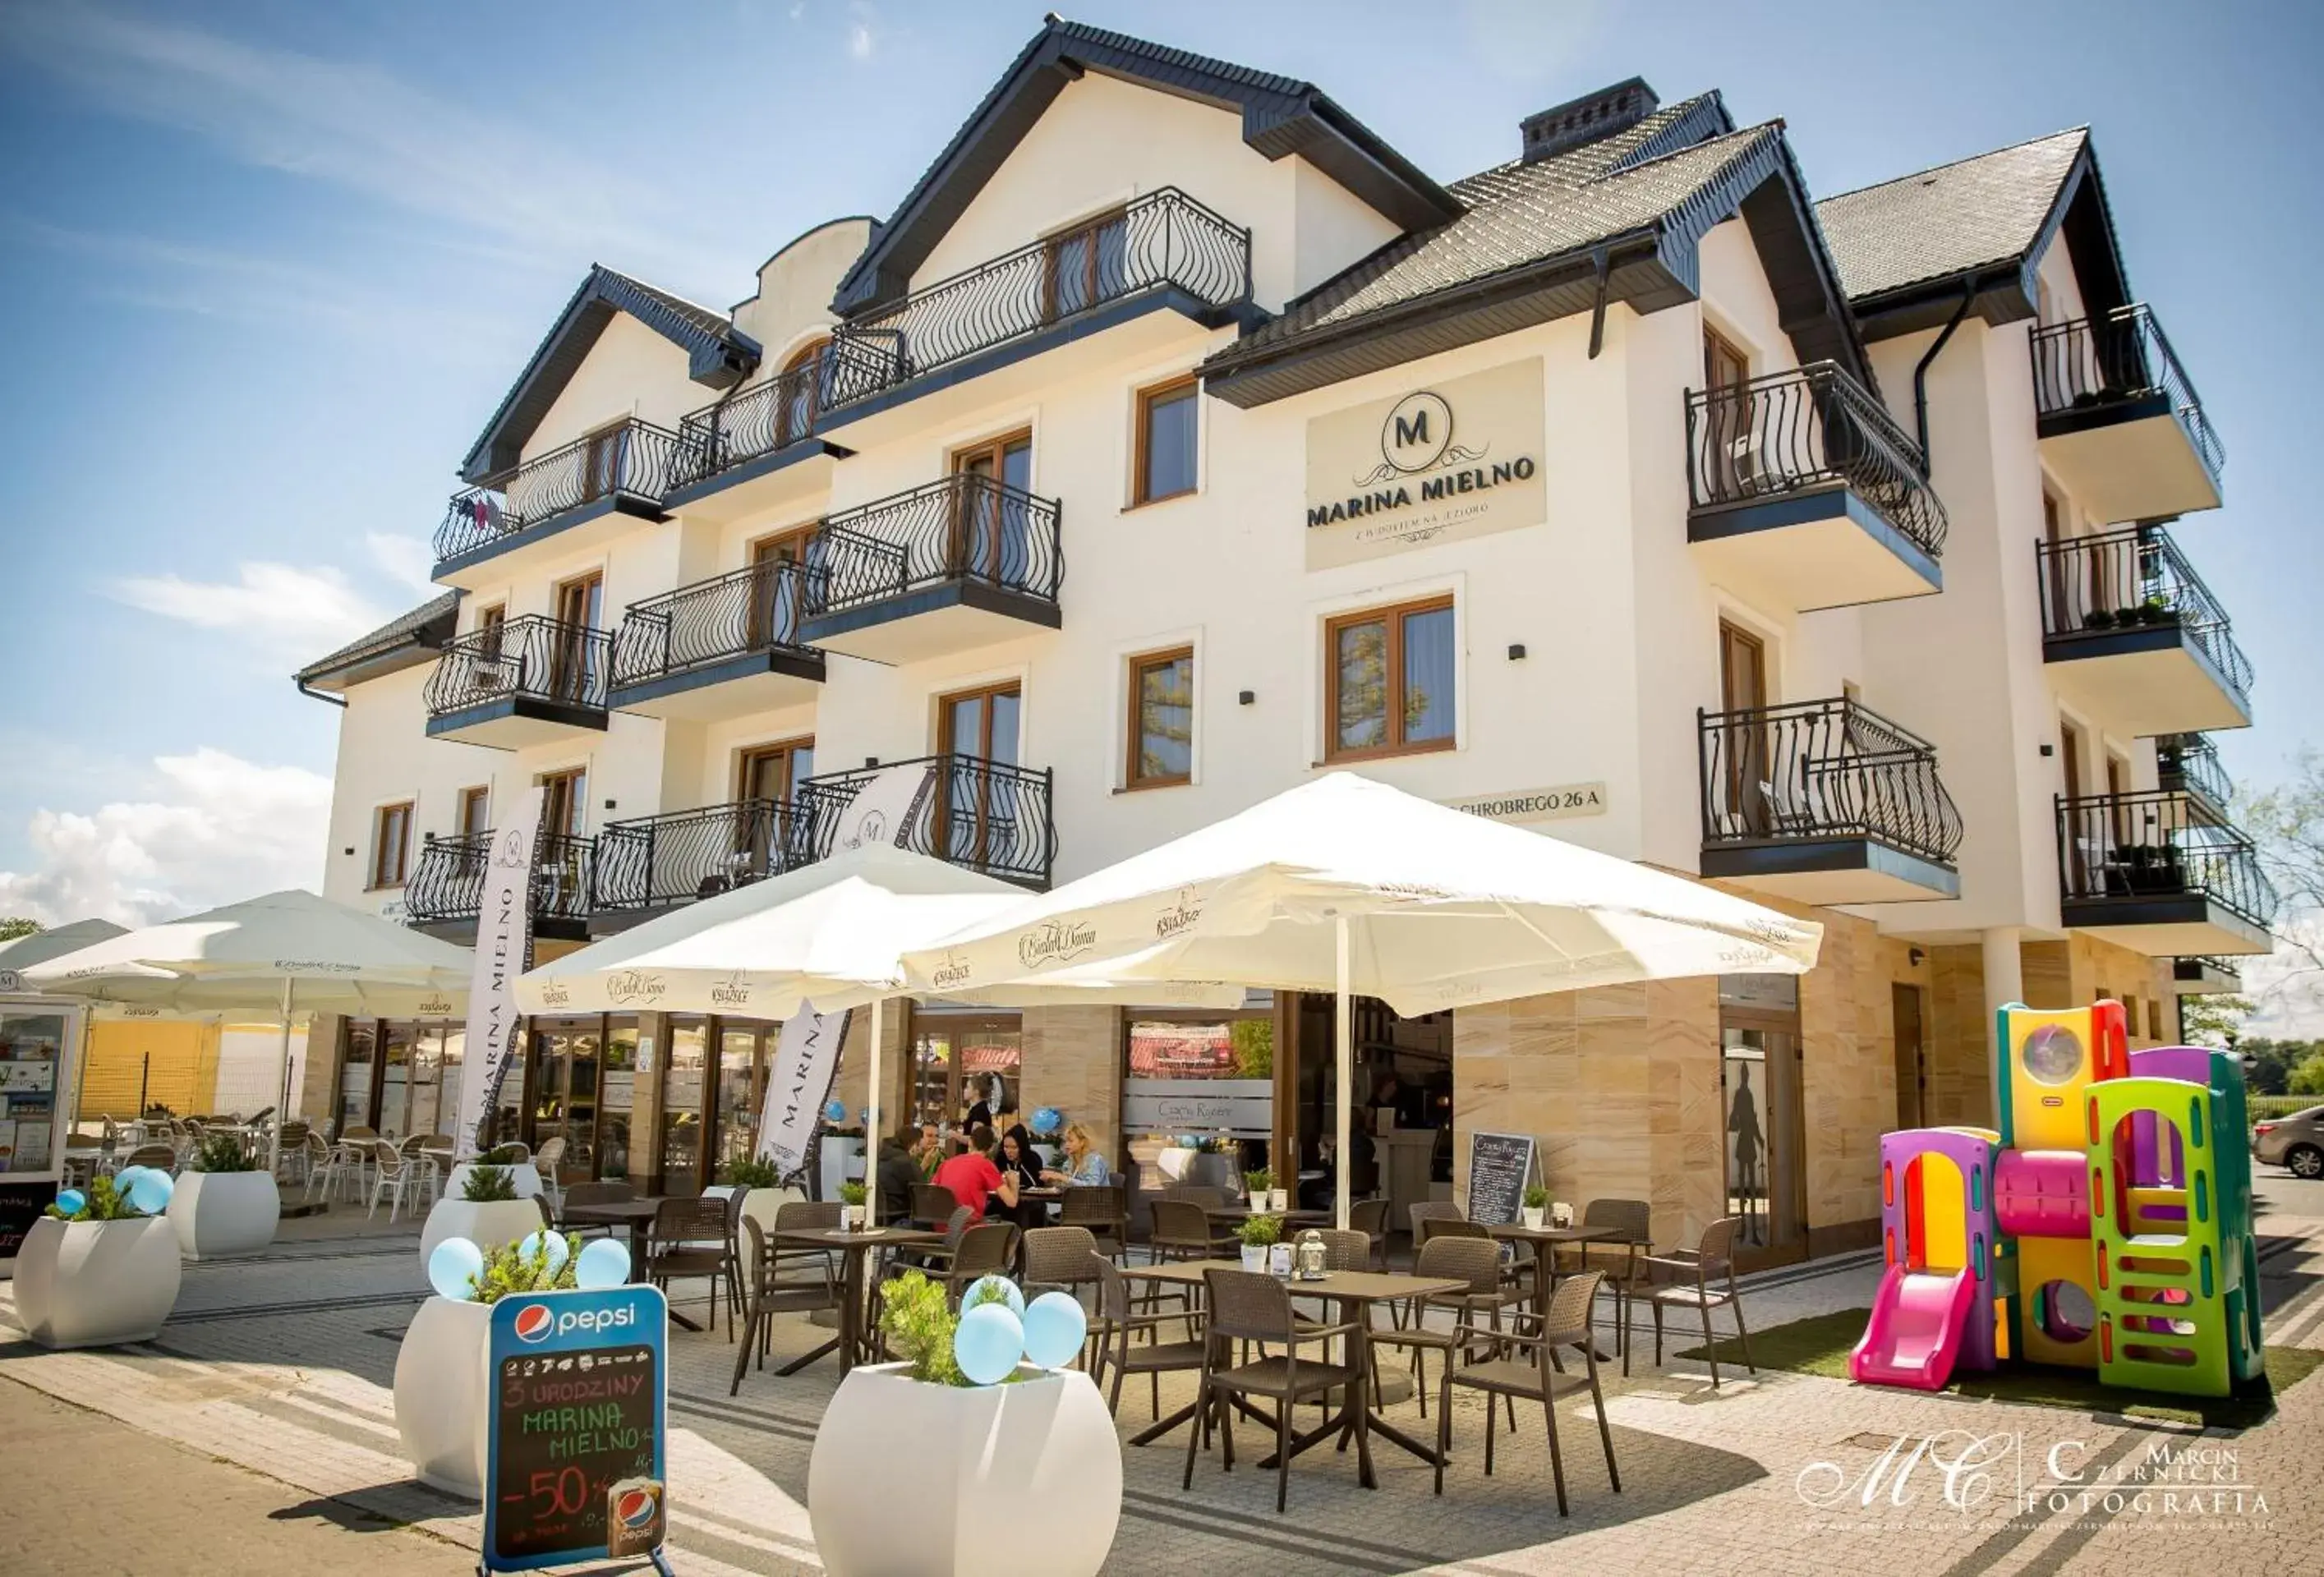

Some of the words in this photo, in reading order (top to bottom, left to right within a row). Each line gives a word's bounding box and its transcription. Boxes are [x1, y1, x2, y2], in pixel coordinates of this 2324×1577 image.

[1396, 410, 1430, 448] M
[1307, 487, 1411, 528] MARINA
[1422, 457, 1535, 502] MIELNO
[1564, 792, 1583, 808] 26
[1587, 791, 1599, 805] A
[491, 888, 513, 992] MIELNO
[782, 1012, 824, 1129] MARINA
[559, 1303, 635, 1336] pepsi
[503, 1380, 527, 1409] 3
[533, 1373, 645, 1404] URODZINY
[522, 1402, 624, 1435] MARINA
[549, 1428, 639, 1460] MIELNO
[619, 1527, 653, 1543] pepsi
